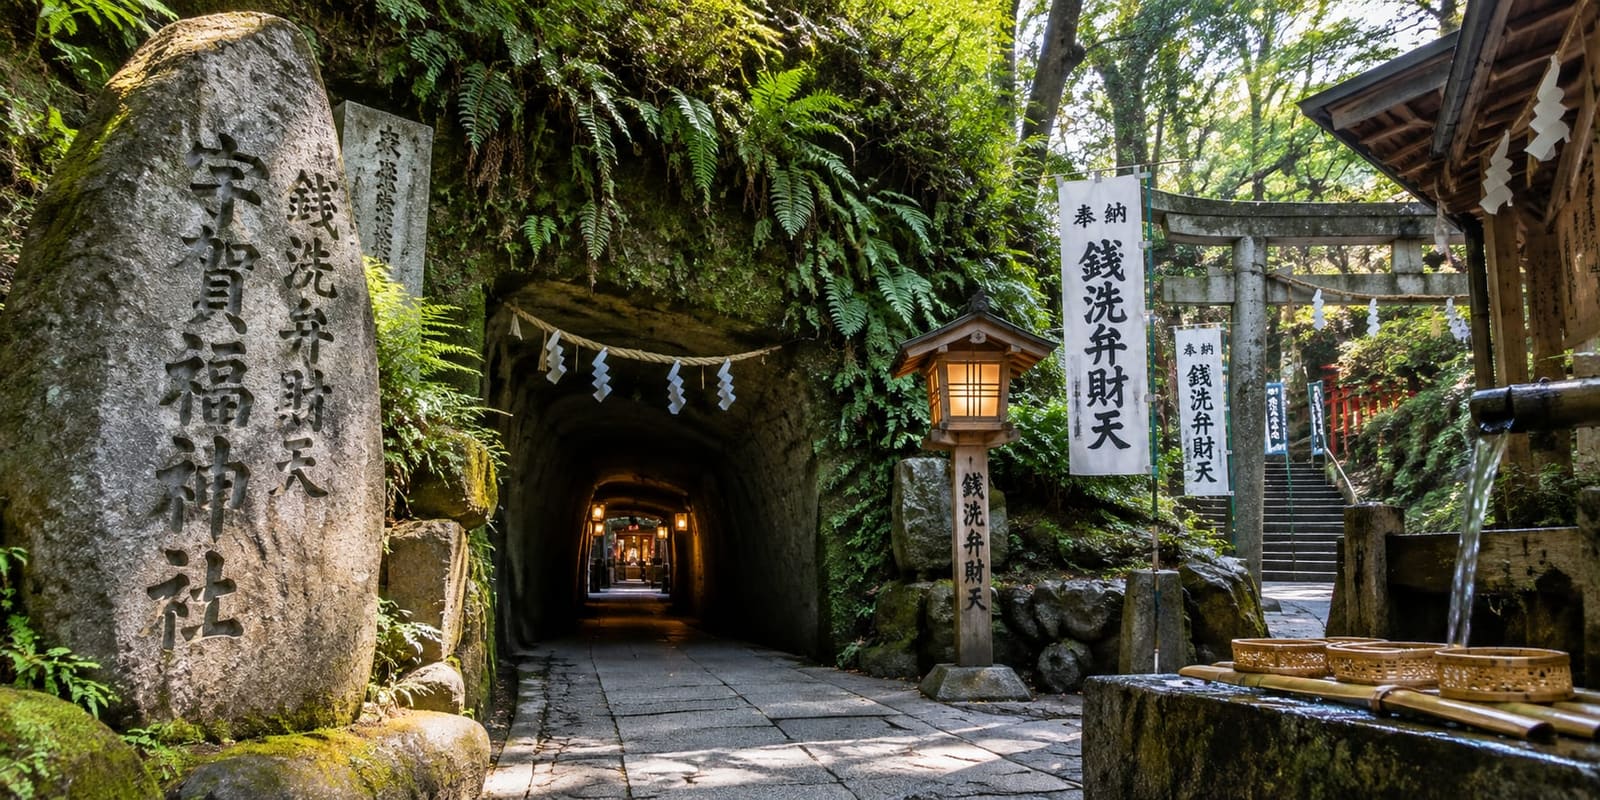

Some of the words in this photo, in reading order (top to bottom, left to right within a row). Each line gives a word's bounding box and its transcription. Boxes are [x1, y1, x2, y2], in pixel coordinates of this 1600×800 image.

[1073, 202, 1128, 229] 奉納
[147, 133, 270, 650] 宇賀福神社
[269, 170, 339, 498] 銭洗弁財天
[1078, 239, 1132, 450] 銭洗弁財天
[1183, 342, 1214, 357] 奉納
[1187, 363, 1218, 483] 銭洗弁財天
[961, 472, 987, 611] 銭洗弁財天
